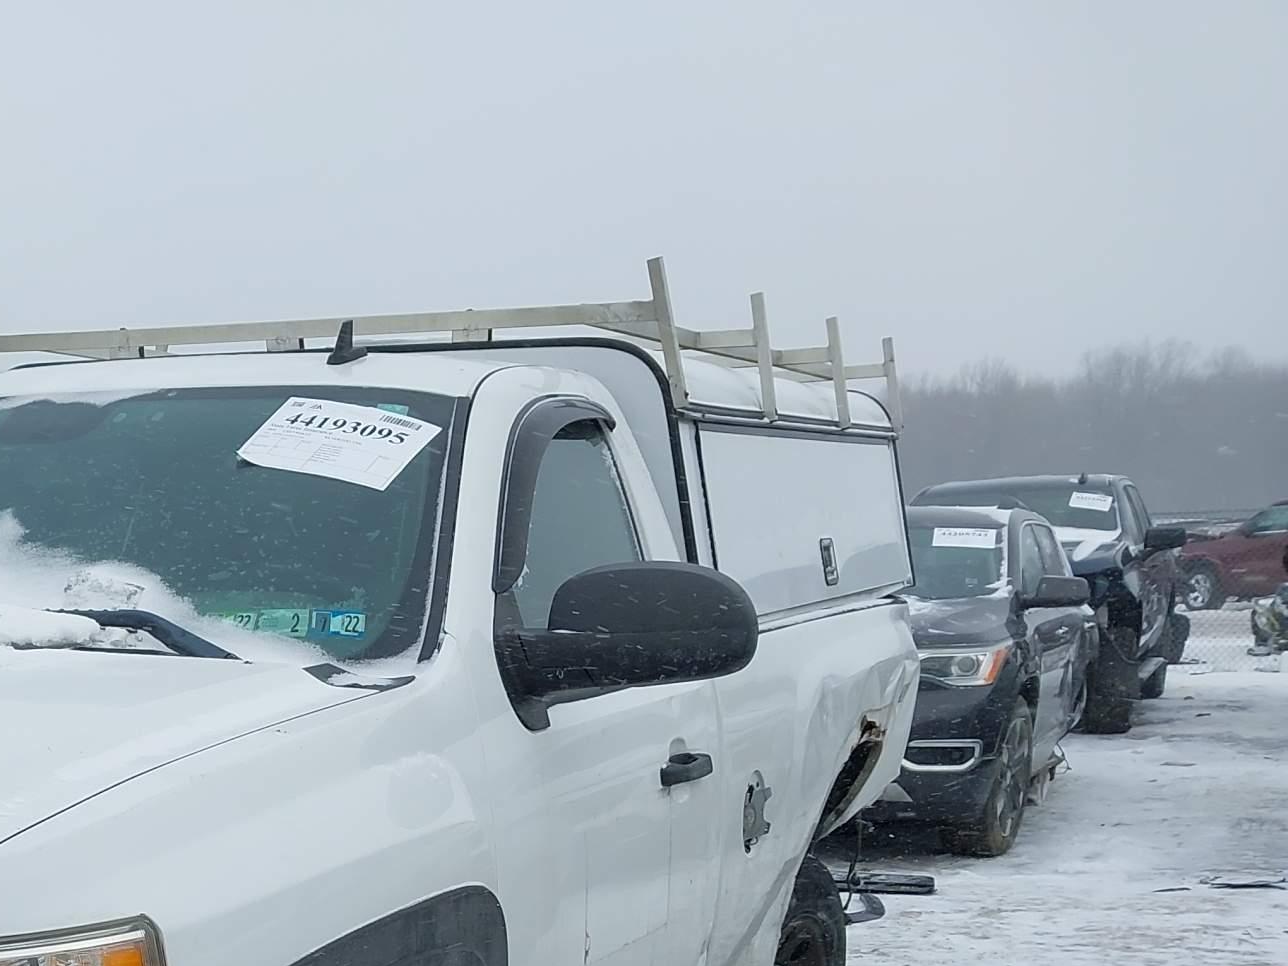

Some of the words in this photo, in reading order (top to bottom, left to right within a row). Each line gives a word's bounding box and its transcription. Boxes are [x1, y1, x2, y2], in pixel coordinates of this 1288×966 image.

[285, 412, 411, 445] 44193095
[290, 612, 301, 633] 2
[344, 614, 360, 633] 22
